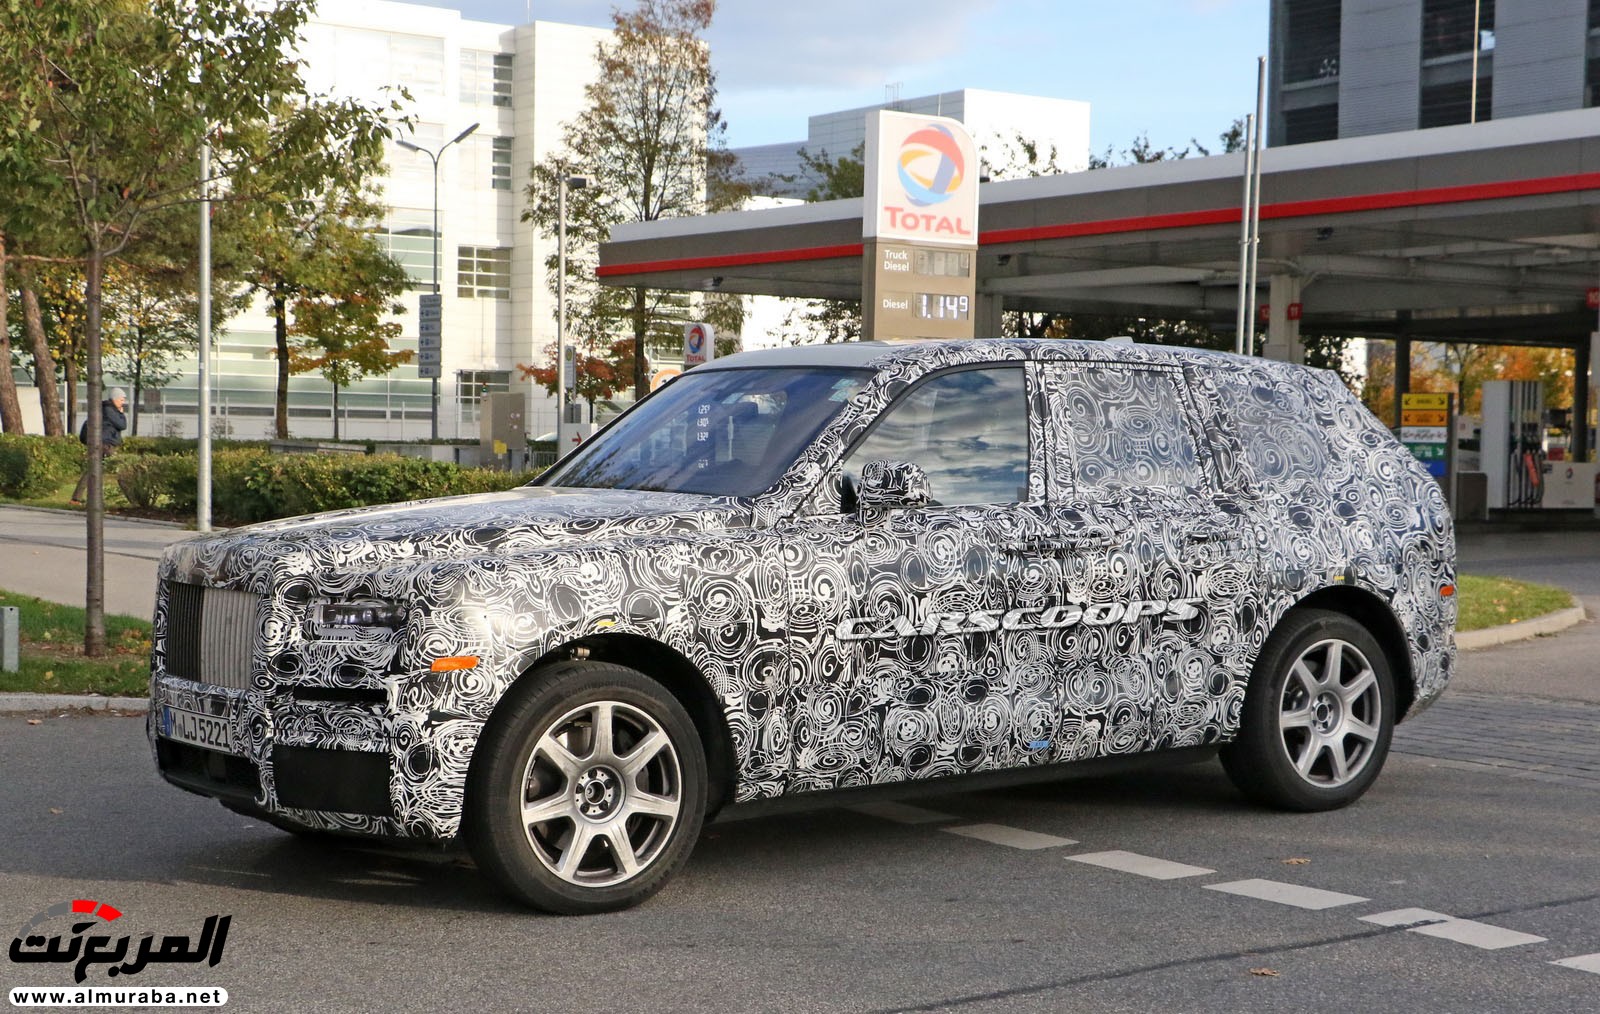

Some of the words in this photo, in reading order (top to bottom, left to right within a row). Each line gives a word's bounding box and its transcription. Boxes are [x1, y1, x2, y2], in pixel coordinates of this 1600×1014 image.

[884, 206, 971, 236] TOTAL
[884, 249, 908, 260] Truck
[884, 261, 909, 272] Diesel
[882, 298, 908, 310] Diesel
[922, 294, 968, 320] 1.149
[686, 354, 706, 363] TOTAL
[199, 719, 231, 748] 5221
